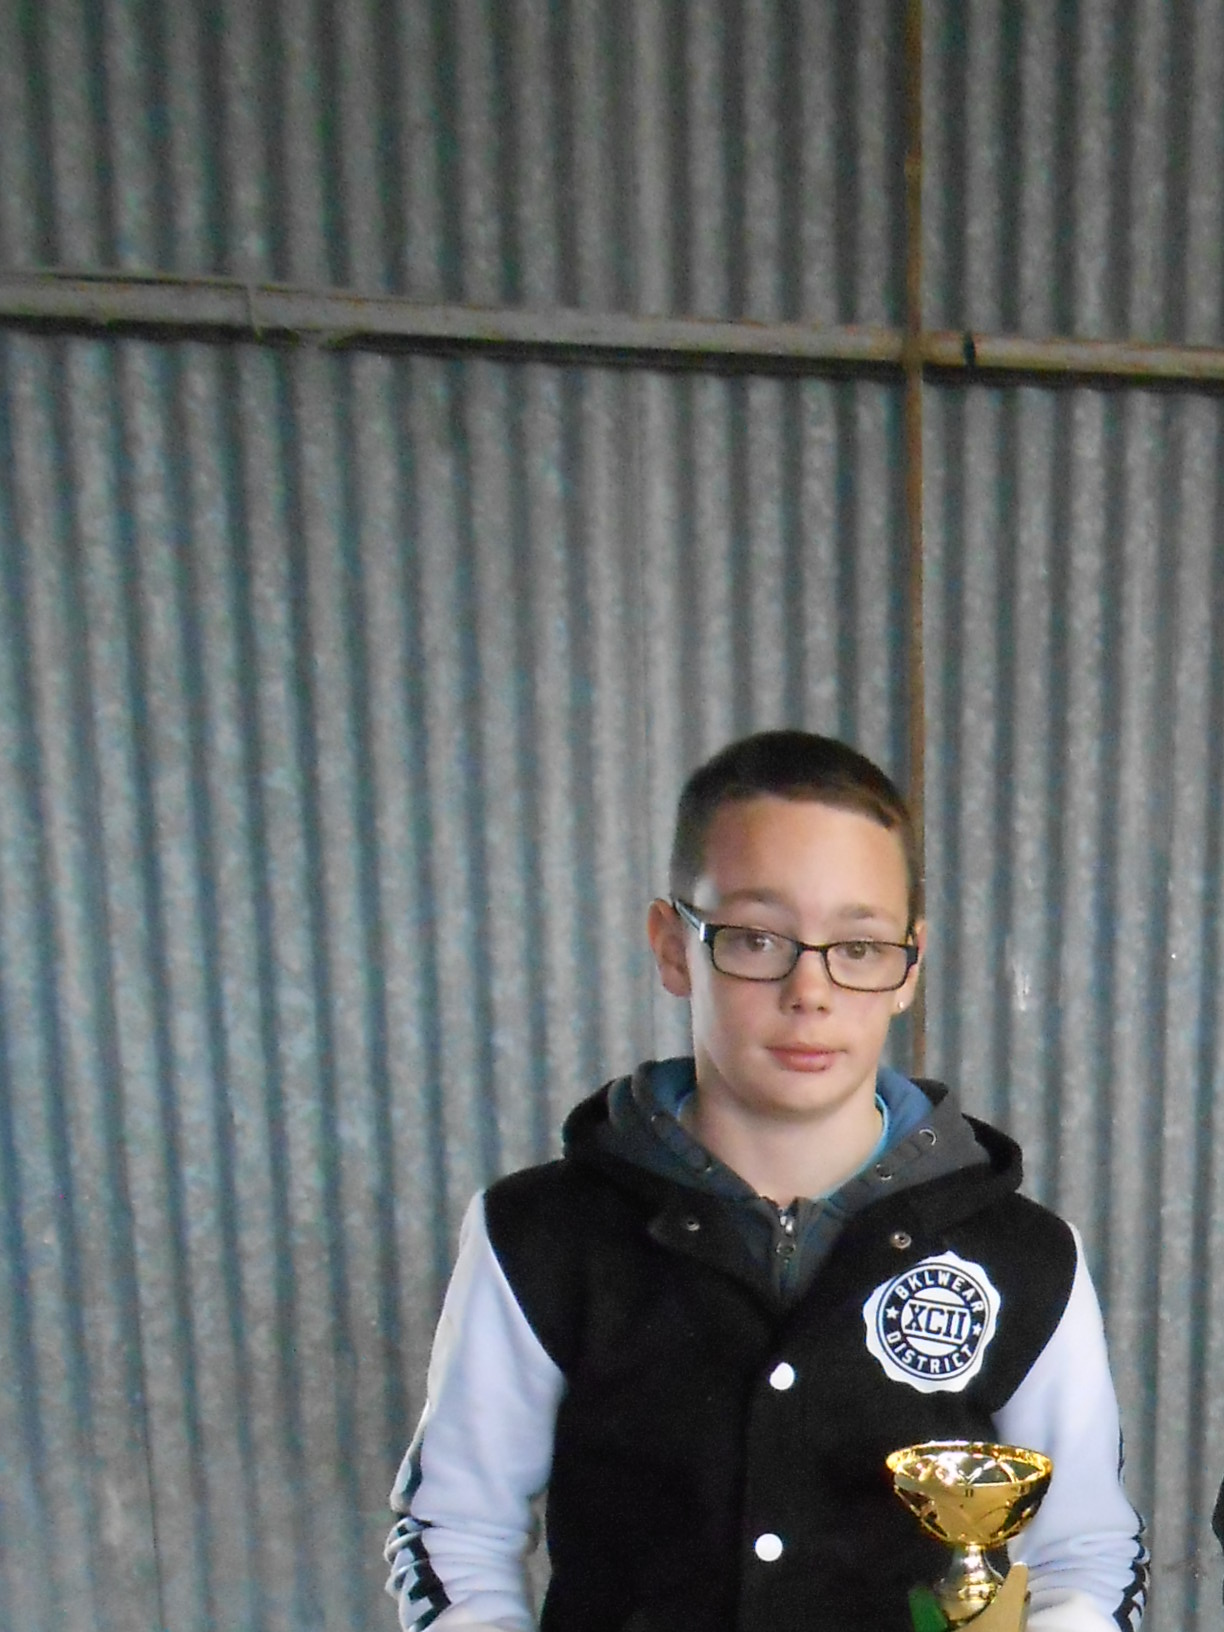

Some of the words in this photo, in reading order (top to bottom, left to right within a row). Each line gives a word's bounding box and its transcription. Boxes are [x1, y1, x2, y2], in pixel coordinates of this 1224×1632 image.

[893, 1270, 985, 1313] BKLWEAR
[904, 1303, 967, 1340] XCII
[886, 1331, 973, 1374] DISTRICT
